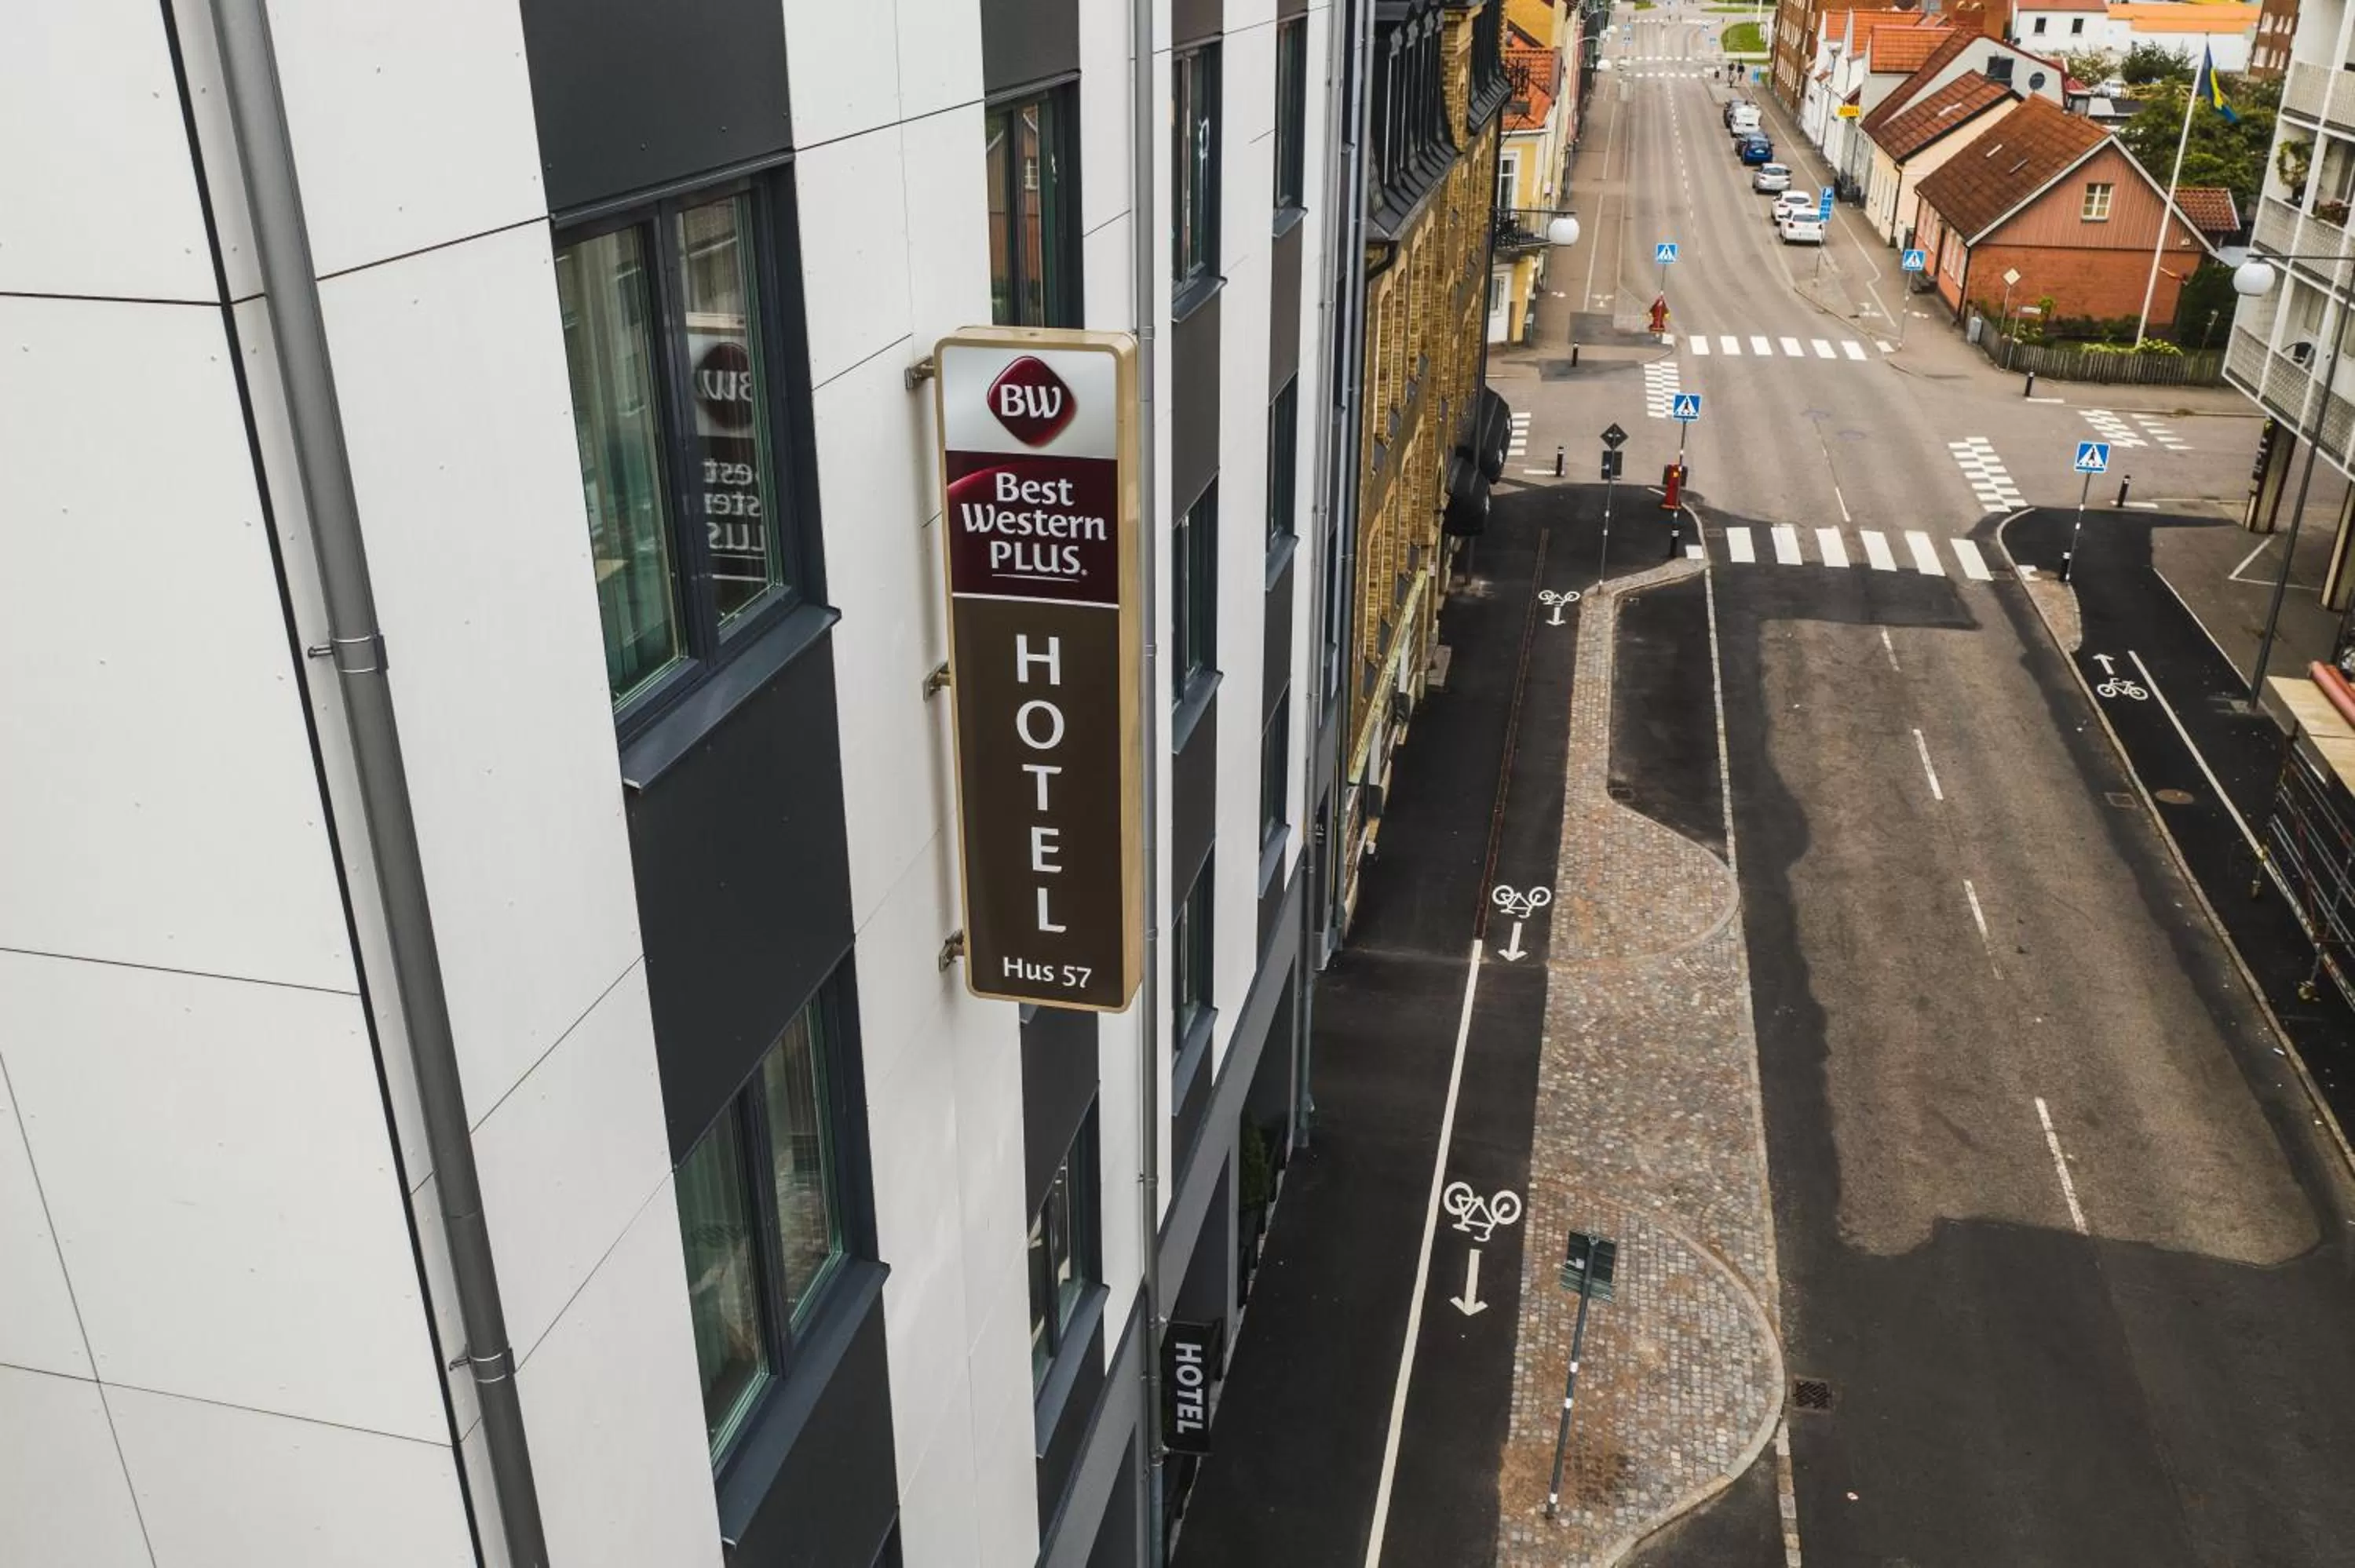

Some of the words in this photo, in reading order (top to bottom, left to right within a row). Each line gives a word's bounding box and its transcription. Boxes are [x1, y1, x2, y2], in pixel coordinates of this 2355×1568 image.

[1000, 384, 1061, 418] BW
[995, 472, 1074, 506] Best
[961, 503, 1107, 541] Western
[1017, 634, 1066, 932] HOTEL
[1003, 957, 1053, 982] Hus
[1062, 965, 1092, 988] 57
[1175, 1343, 1203, 1434] HOTEL
